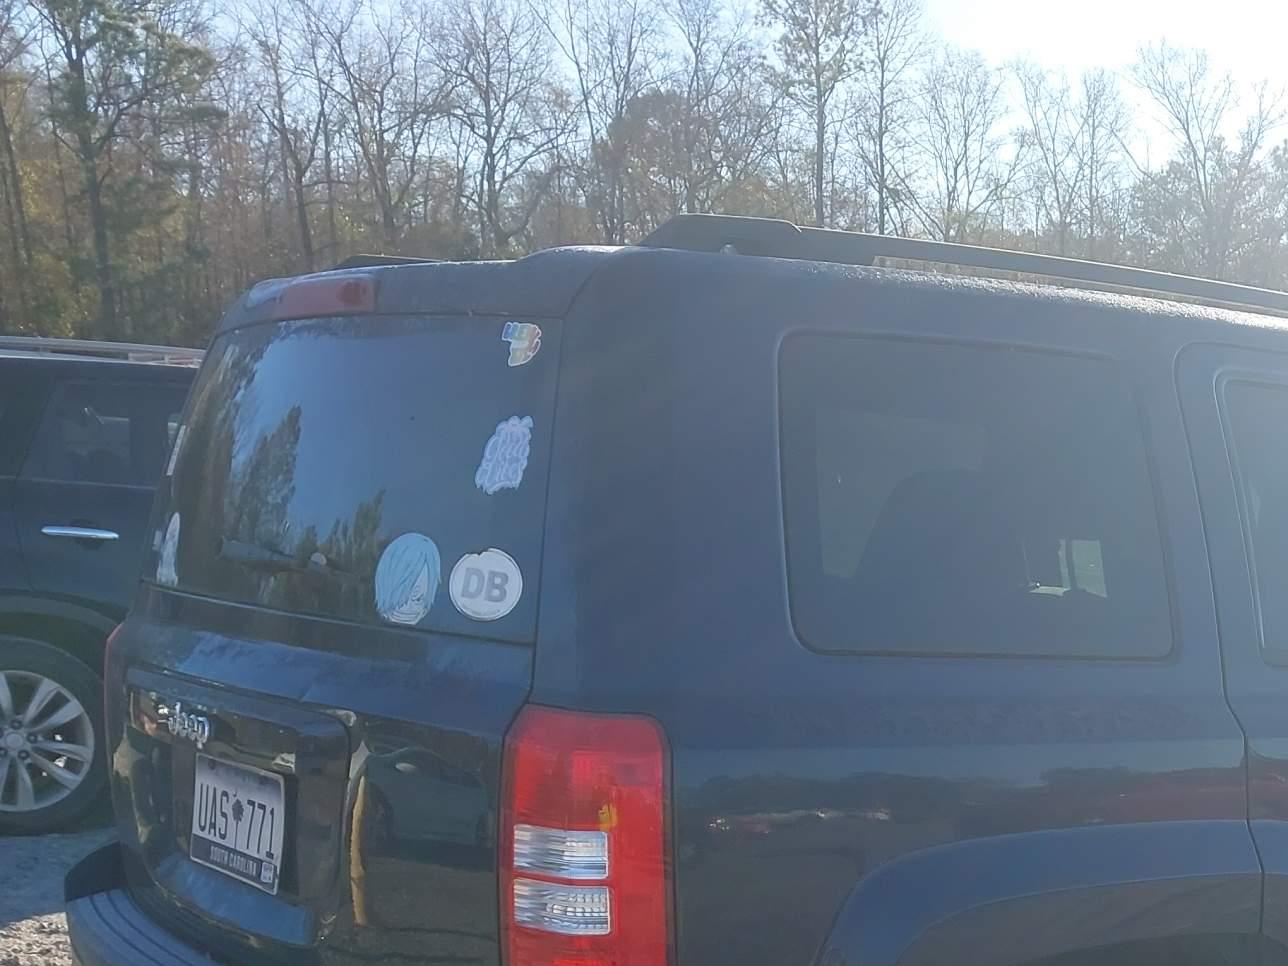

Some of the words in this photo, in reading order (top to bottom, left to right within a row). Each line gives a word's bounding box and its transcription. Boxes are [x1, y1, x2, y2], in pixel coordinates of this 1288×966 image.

[460, 567, 509, 603] DB
[198, 783, 230, 841] UAS
[246, 798, 275, 860] 771
